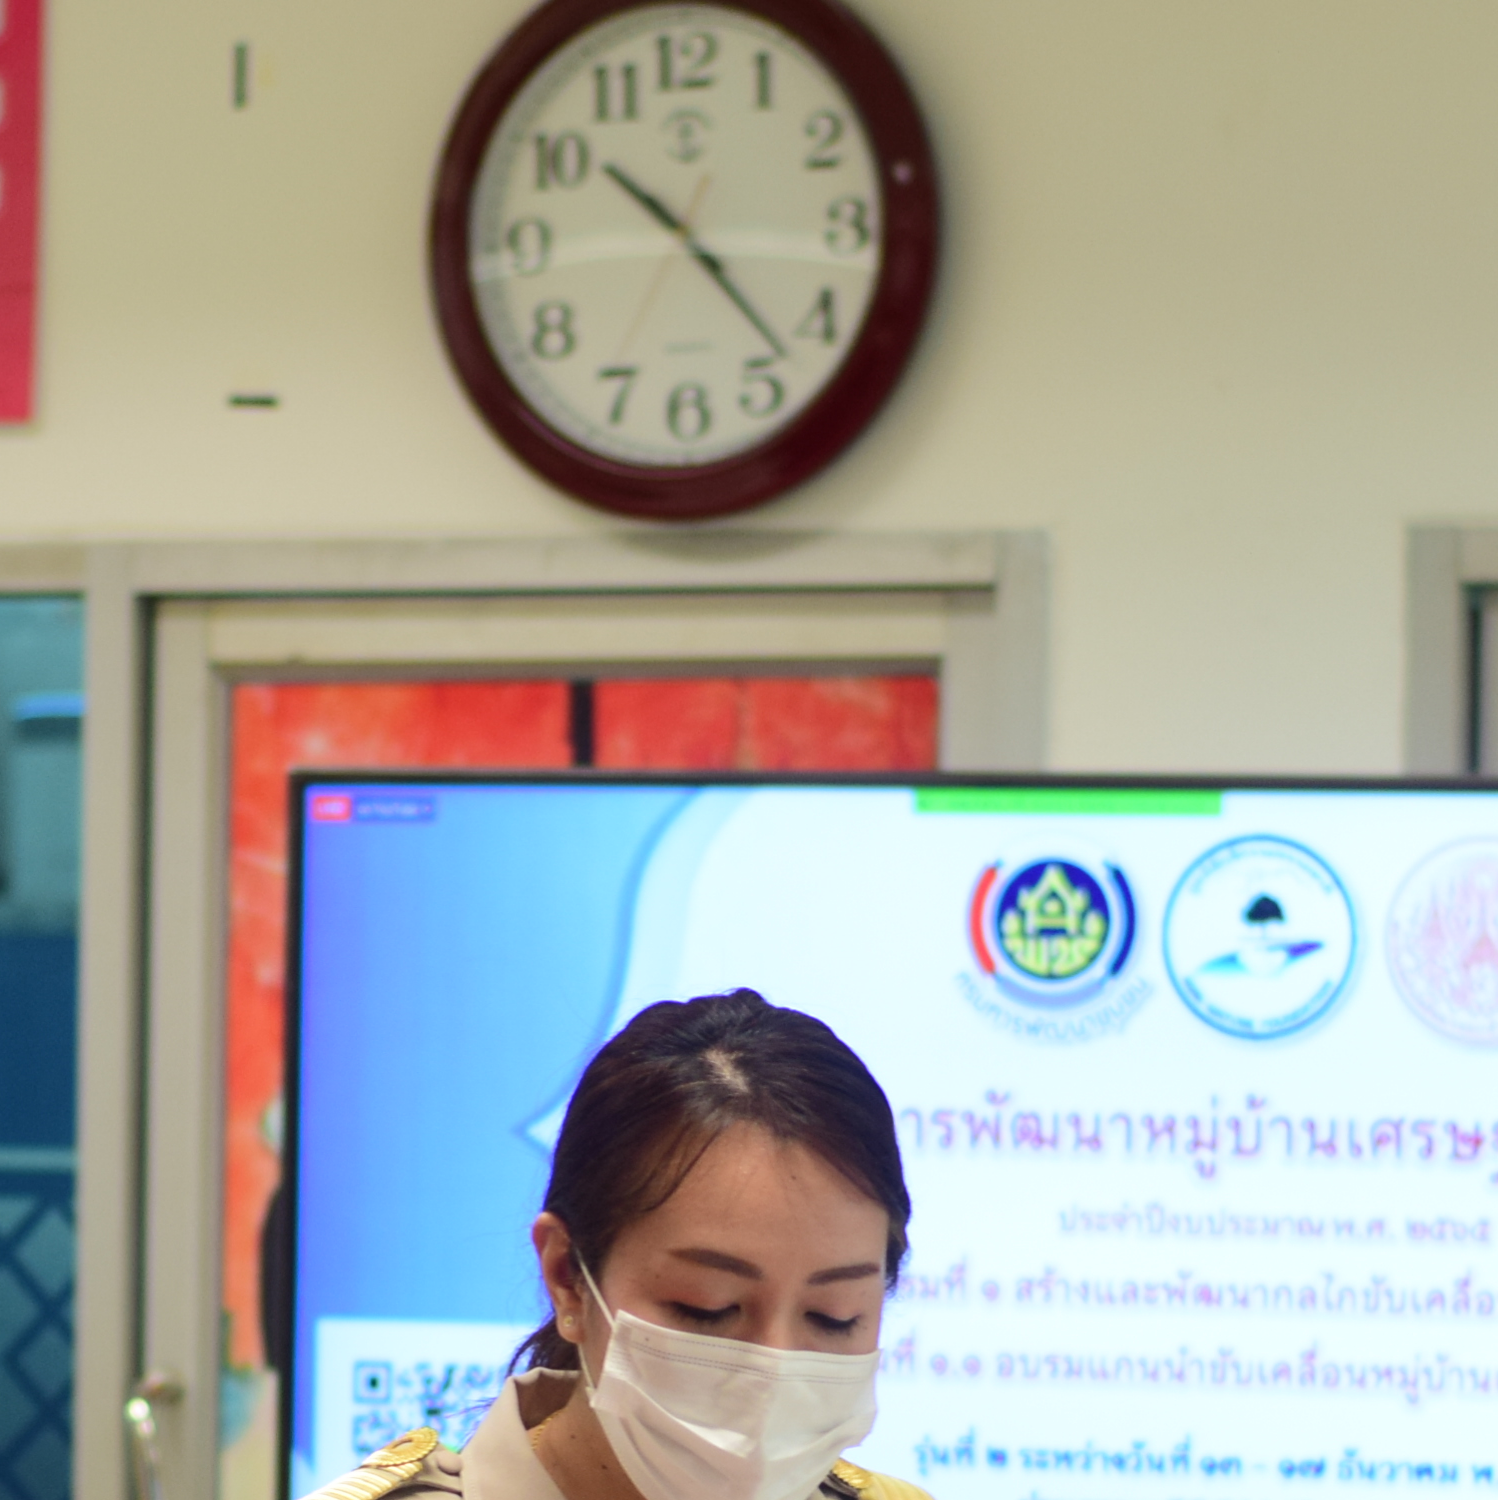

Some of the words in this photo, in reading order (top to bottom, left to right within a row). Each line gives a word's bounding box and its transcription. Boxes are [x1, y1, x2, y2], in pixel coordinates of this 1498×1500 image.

[656, 32, 719, 91] 12
[754, 49, 772, 110] 1
[593, 61, 640, 123] 11
[535, 131, 591, 191] 10
[804, 109, 844, 169] 2
[506, 216, 552, 277] 9
[823, 197, 871, 257] 3
[531, 302, 576, 360] 8
[795, 286, 837, 346] 4
[598, 366, 639, 427] 7
[665, 381, 713, 442] 6
[737, 356, 785, 417] 5
[898, 1254, 967, 1301] รมที่
